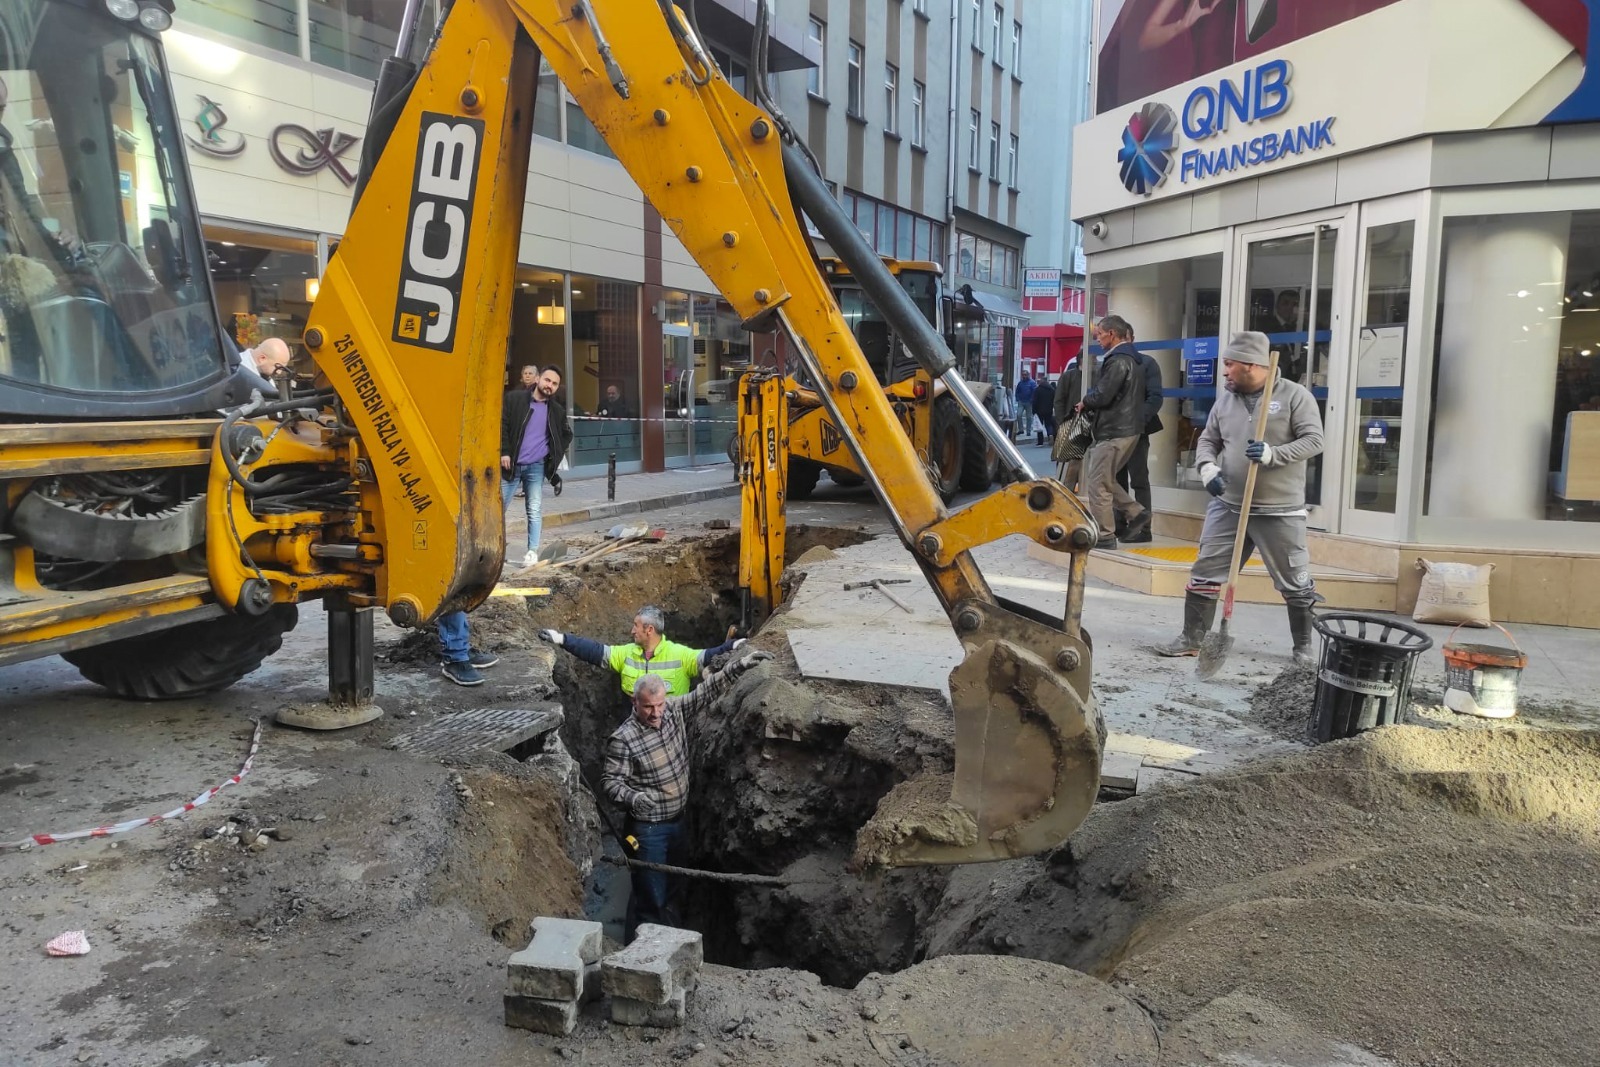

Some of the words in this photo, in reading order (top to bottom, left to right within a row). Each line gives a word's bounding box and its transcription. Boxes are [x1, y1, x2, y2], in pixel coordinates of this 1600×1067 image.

[1181, 59, 1293, 140] QNB
[403, 121, 477, 345] JCB
[333, 333, 354, 354] 25
[341, 349, 386, 416] METREDEN
[371, 411, 402, 453] FAZLA
